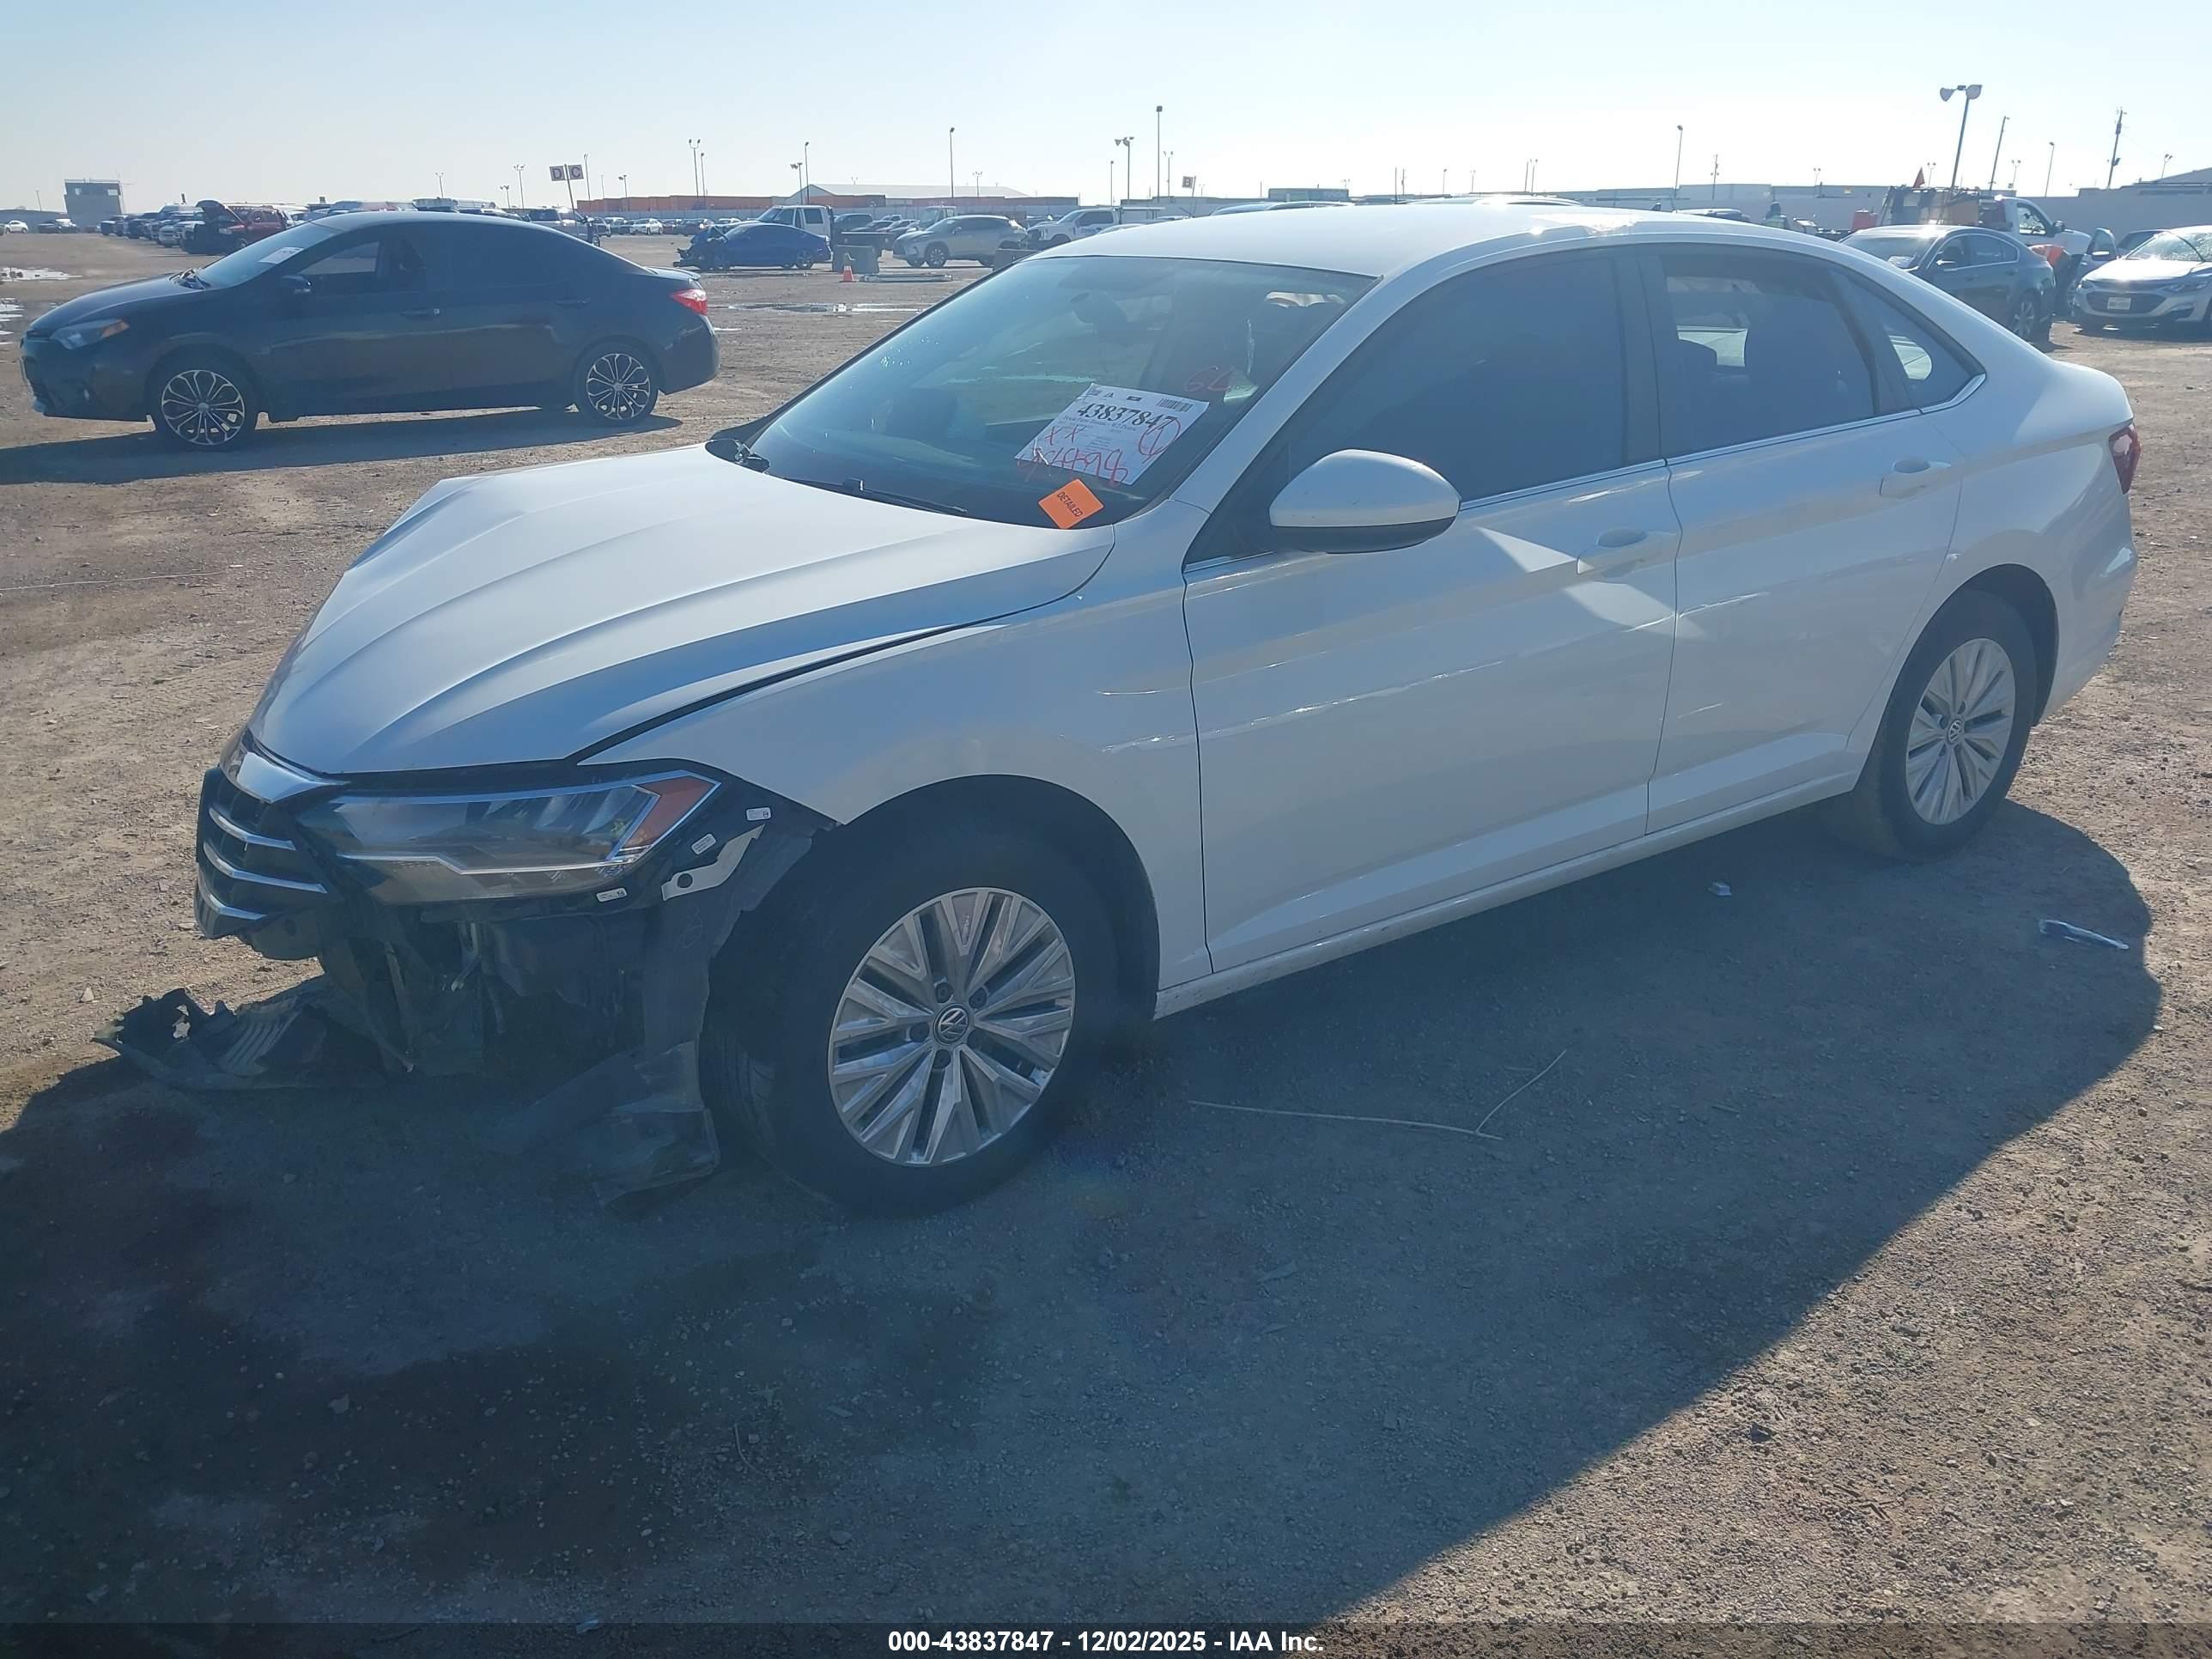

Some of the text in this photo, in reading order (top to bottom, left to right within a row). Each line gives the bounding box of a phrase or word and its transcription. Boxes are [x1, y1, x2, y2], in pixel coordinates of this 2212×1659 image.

[551, 167, 562, 179] D
[570, 166, 581, 179] C
[1077, 403, 1178, 429] 43837847
[1057, 491, 1083, 517] DETAILED
